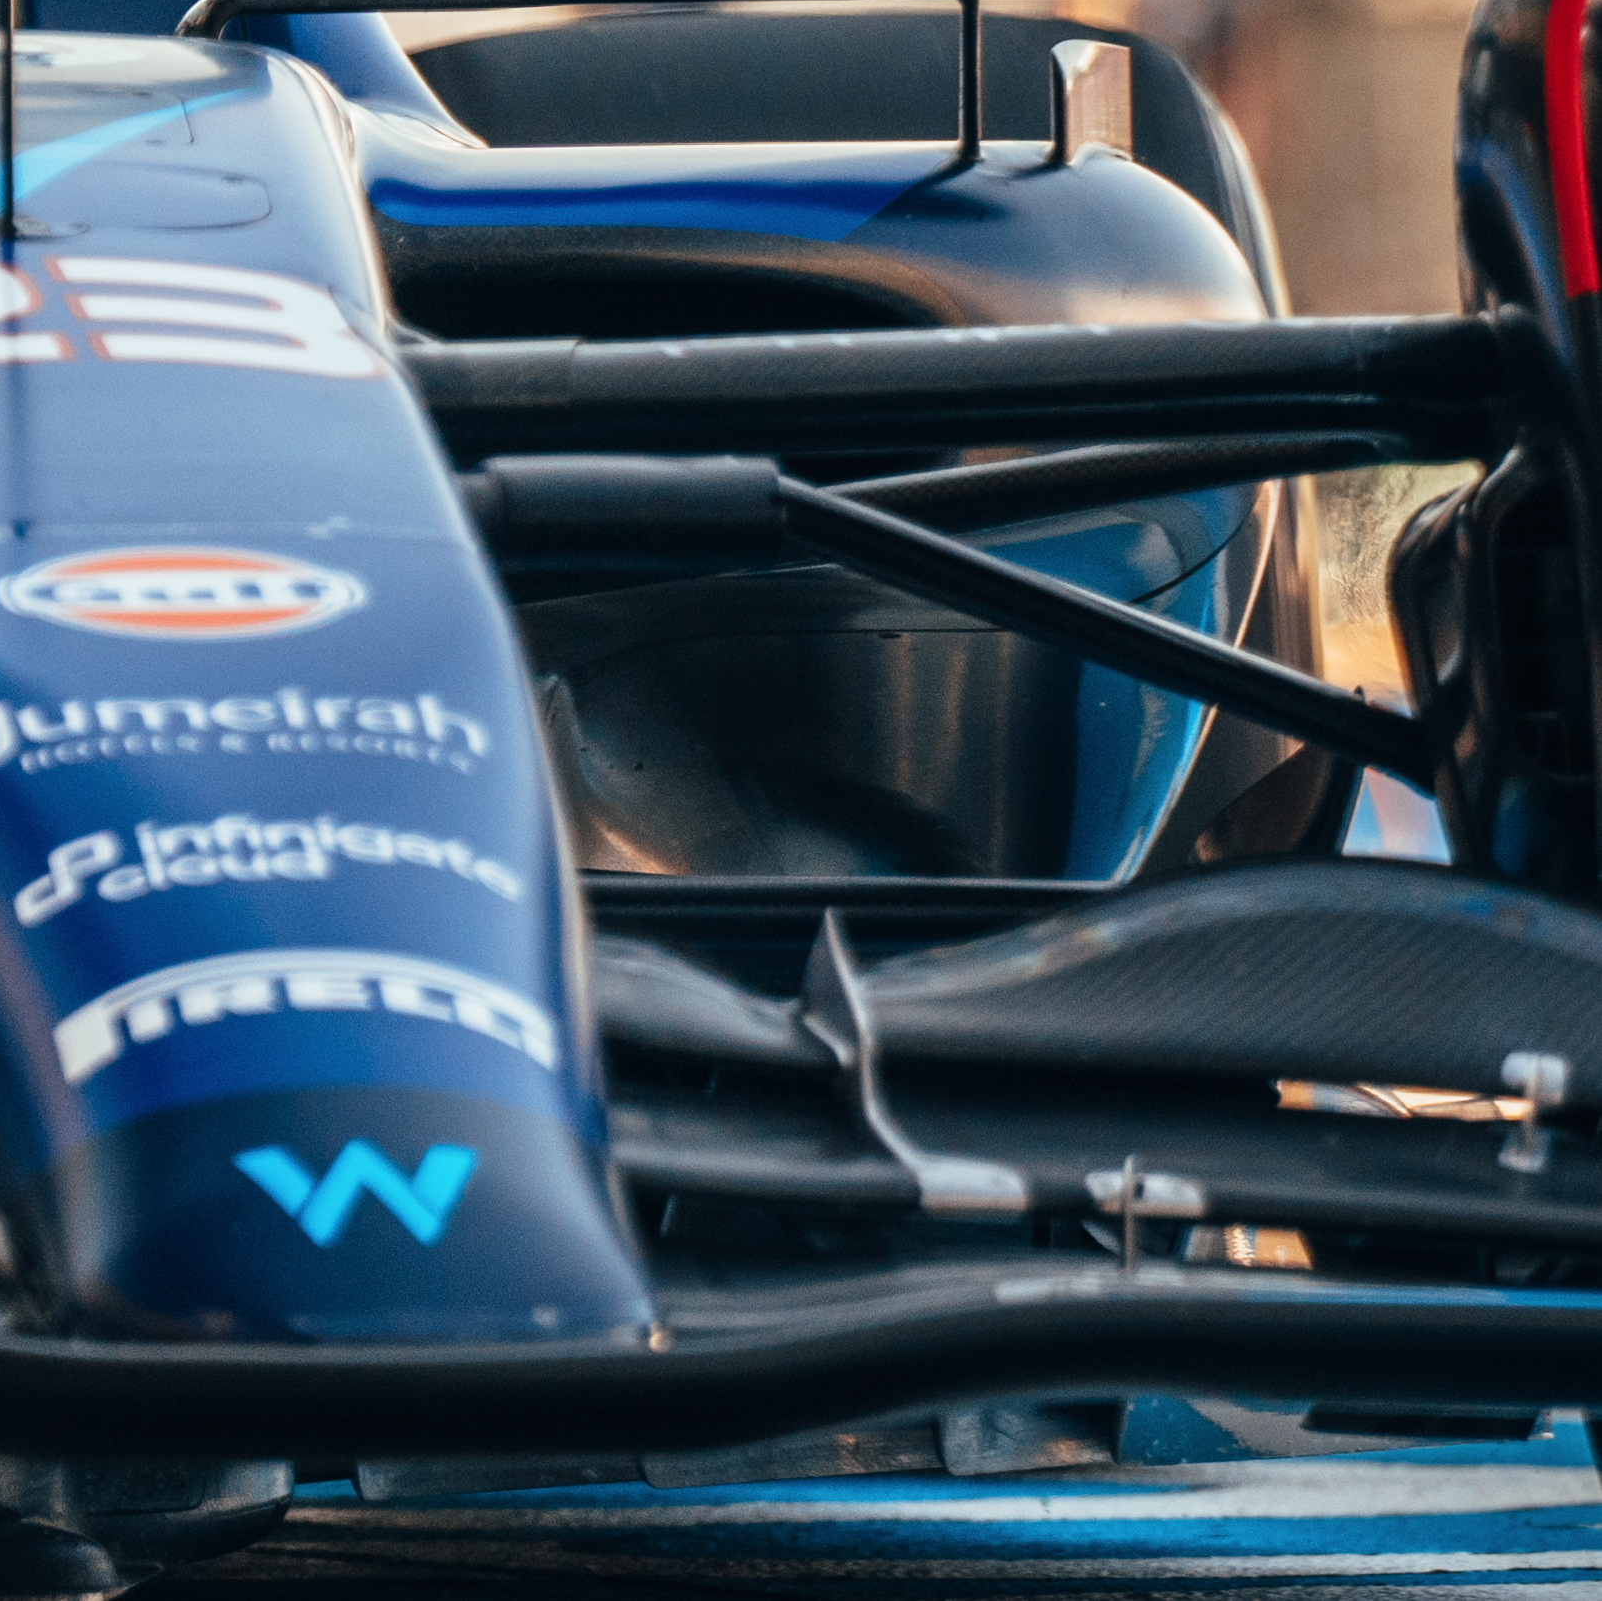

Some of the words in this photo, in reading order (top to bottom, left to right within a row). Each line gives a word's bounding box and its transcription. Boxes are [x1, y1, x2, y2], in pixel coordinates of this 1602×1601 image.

[97, 838, 333, 901] cloud
[135, 812, 526, 900] infinigate
[53, 948, 557, 1086] PIRELLI
